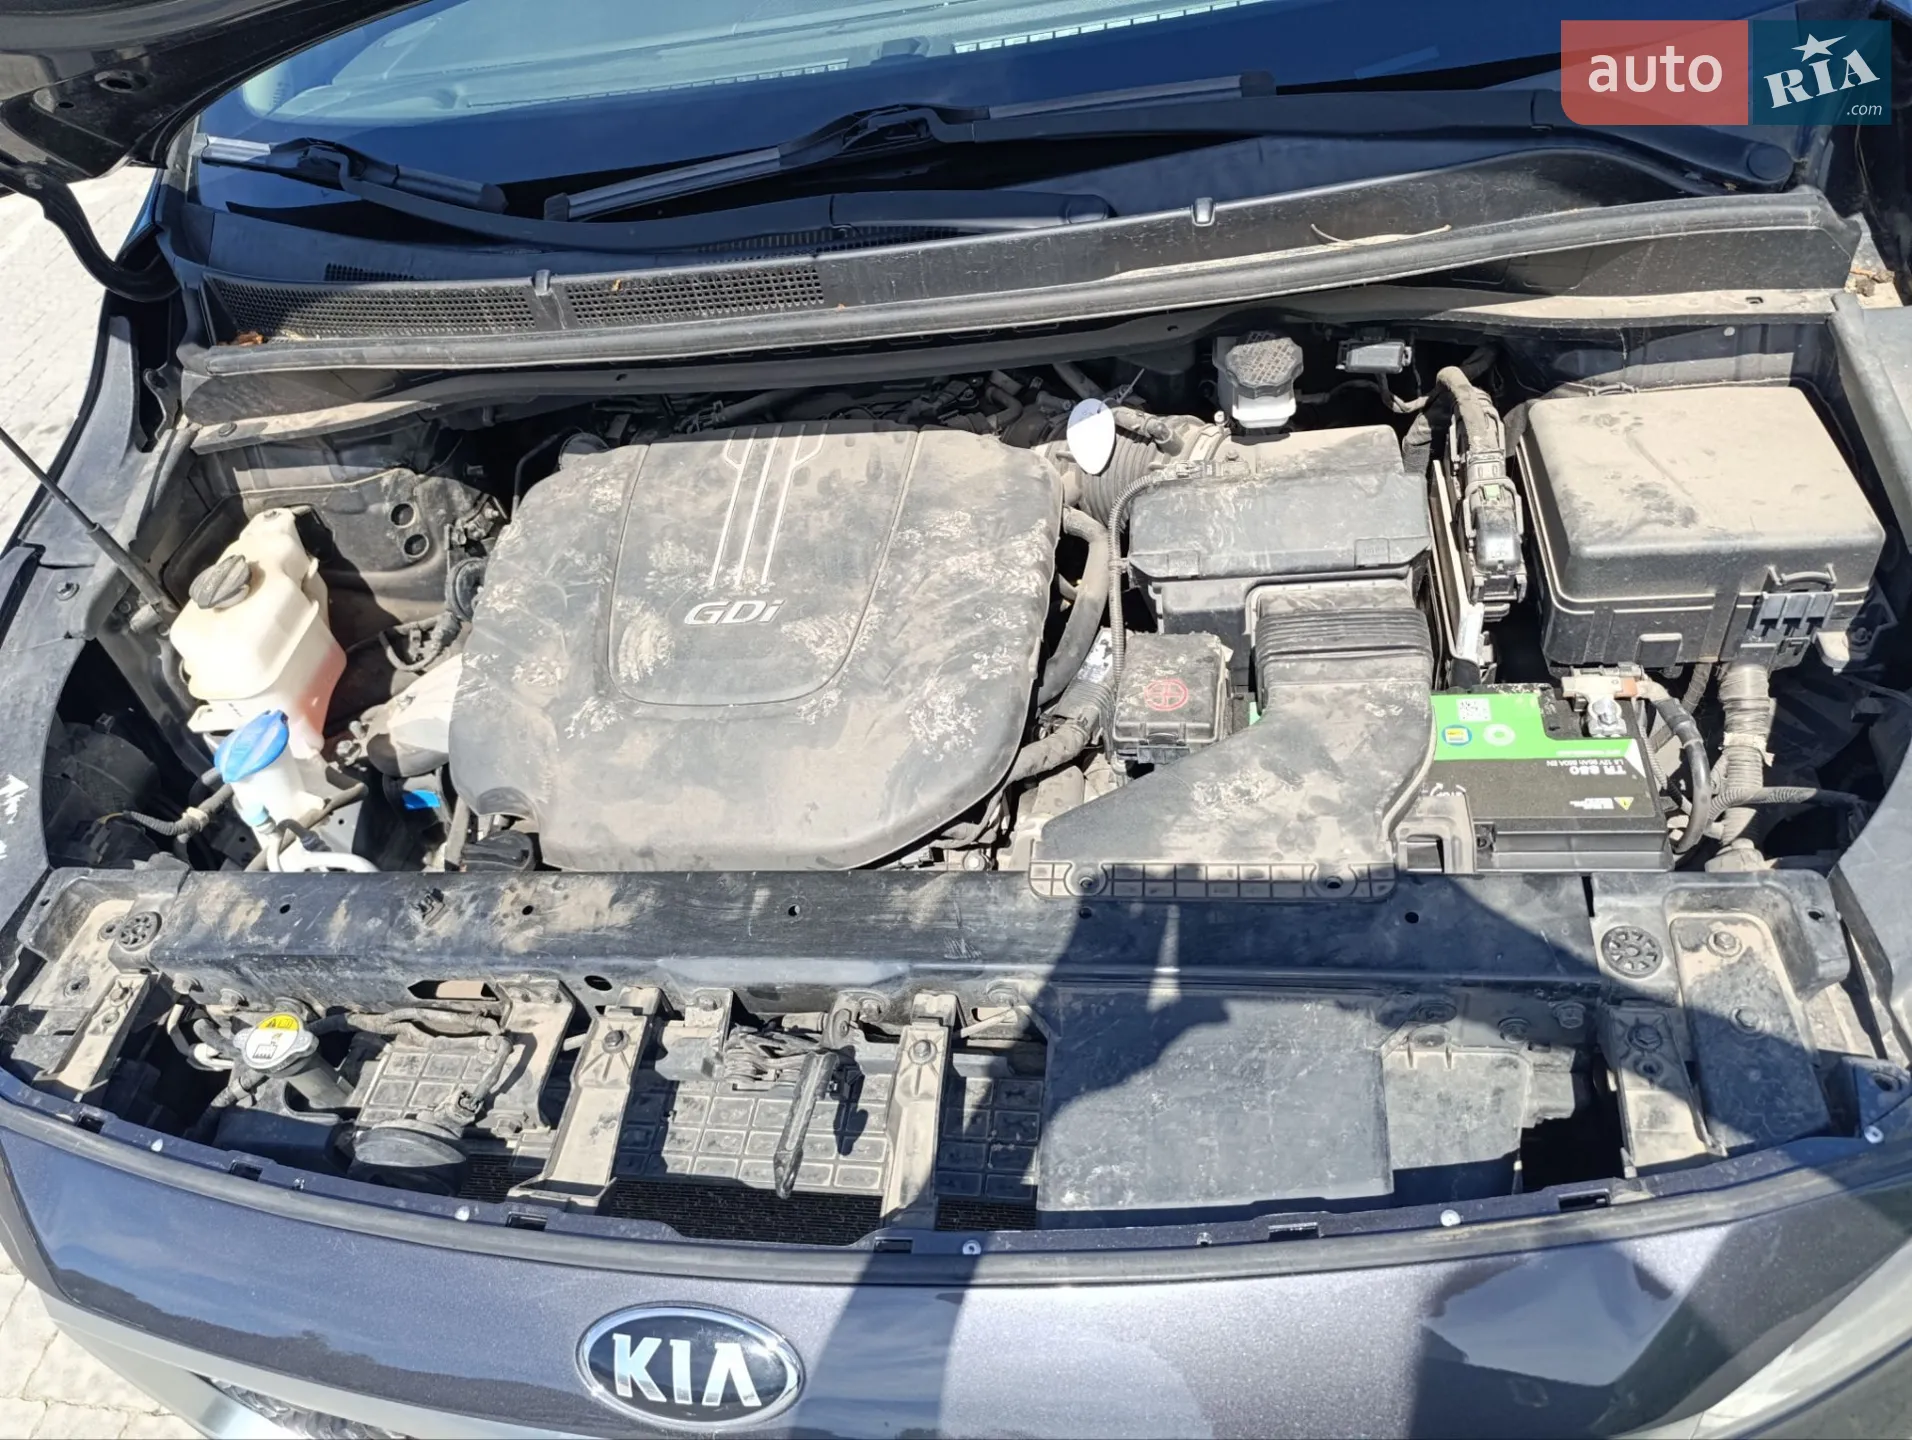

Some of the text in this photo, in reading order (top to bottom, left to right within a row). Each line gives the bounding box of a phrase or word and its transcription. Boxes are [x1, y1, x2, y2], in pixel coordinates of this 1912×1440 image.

[684, 599, 786, 625] GDi
[1603, 765, 1627, 775] TR
[612, 1332, 763, 1407] KIA
